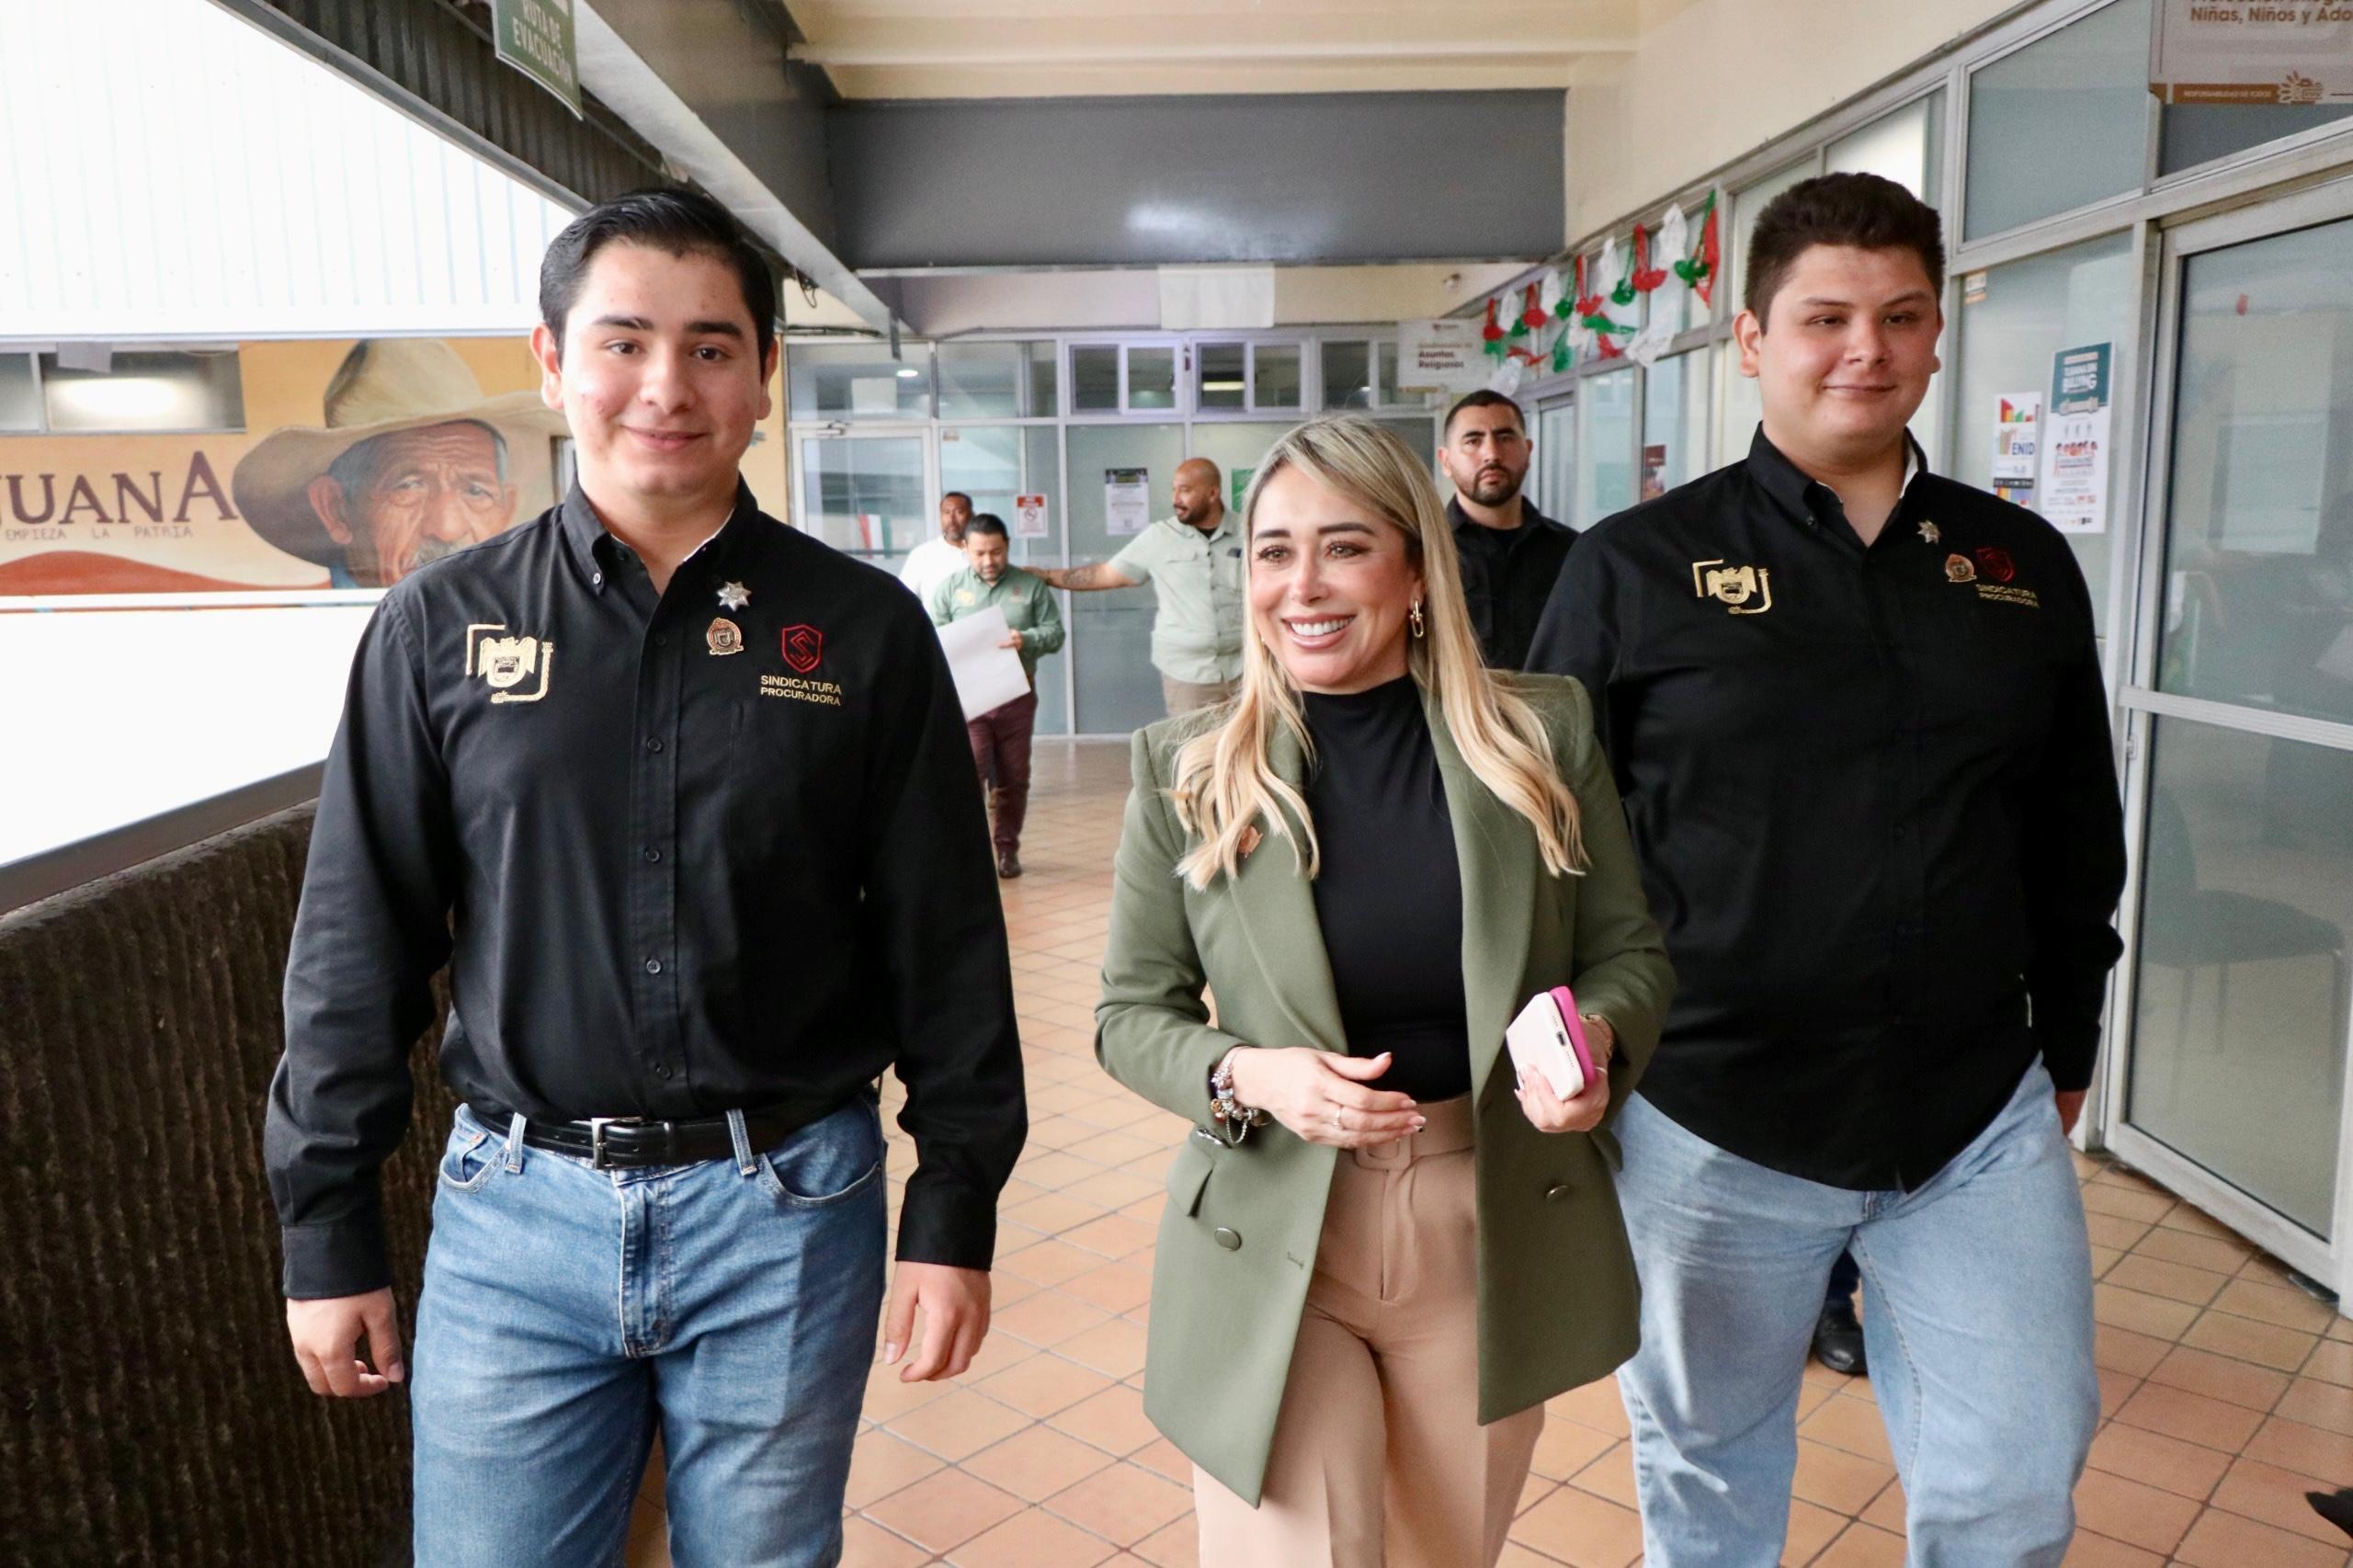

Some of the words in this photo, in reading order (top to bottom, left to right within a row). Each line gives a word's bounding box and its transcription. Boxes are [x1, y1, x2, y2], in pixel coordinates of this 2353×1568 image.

[2190, 6, 2243, 24] Niñas,
[2248, 6, 2296, 22] Niños
[2302, 10, 2312, 25] y
[0, 450, 239, 525] UANA
[760, 675, 842, 696] SINDICATURA
[760, 687, 842, 707] PROCURADORA
